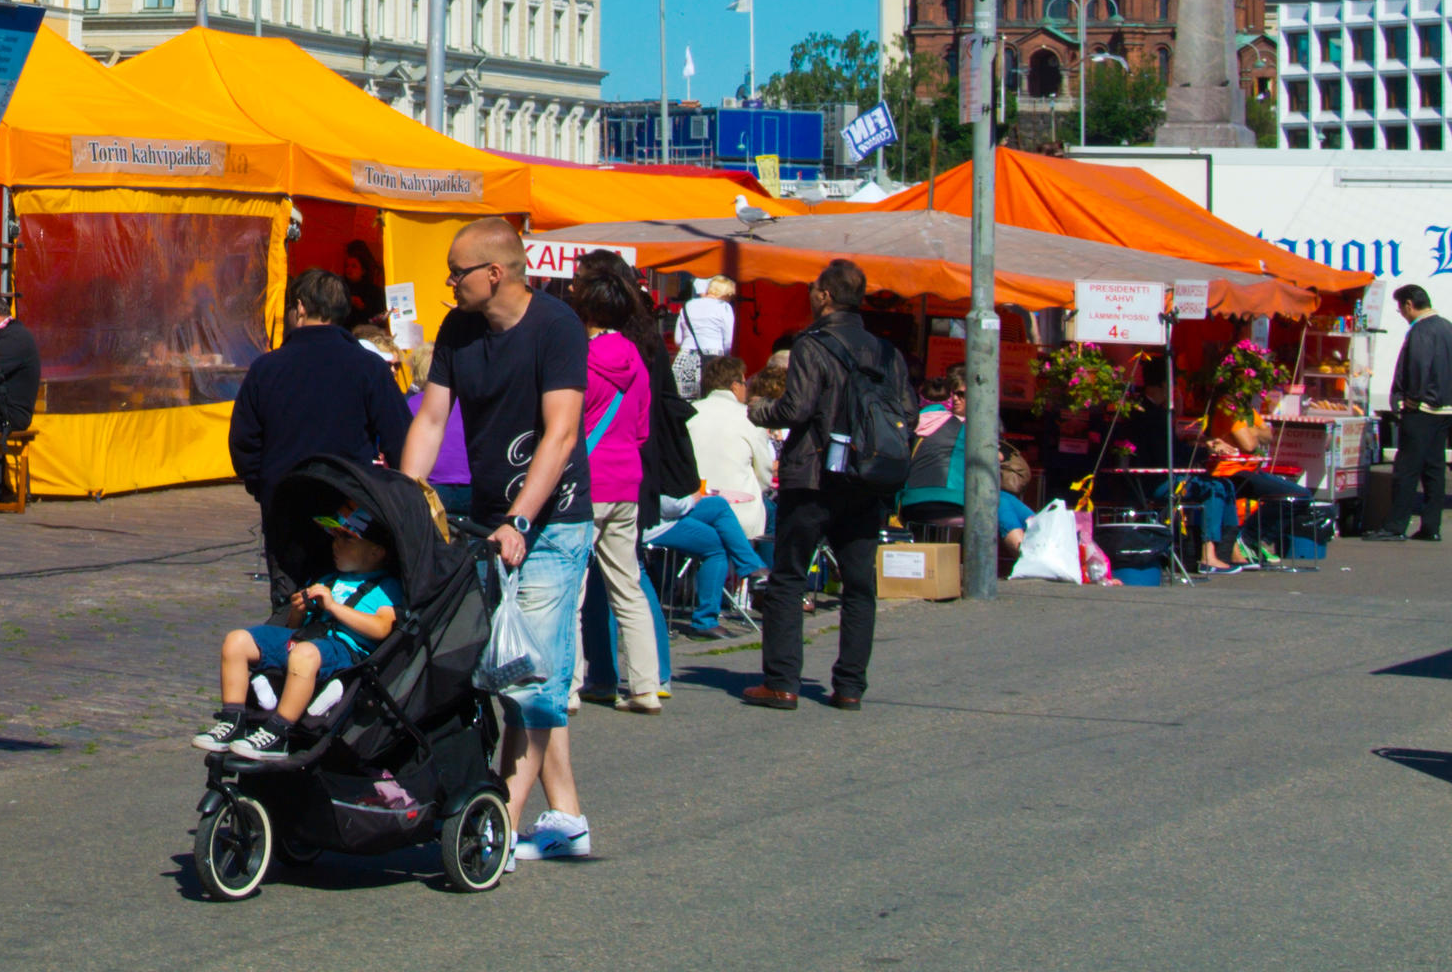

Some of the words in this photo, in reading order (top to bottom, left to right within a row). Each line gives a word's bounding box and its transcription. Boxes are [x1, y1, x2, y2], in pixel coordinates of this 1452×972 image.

[88, 140, 129, 164] Torin
[131, 142, 211, 170] kahvipaikka
[365, 166, 397, 189] Torin
[401, 170, 471, 193] kahvipaikka
[1089, 284, 1150, 293] PRESIDENTTI
[1105, 294, 1134, 302] KAHVI
[1122, 313, 1150, 321] POSSU
